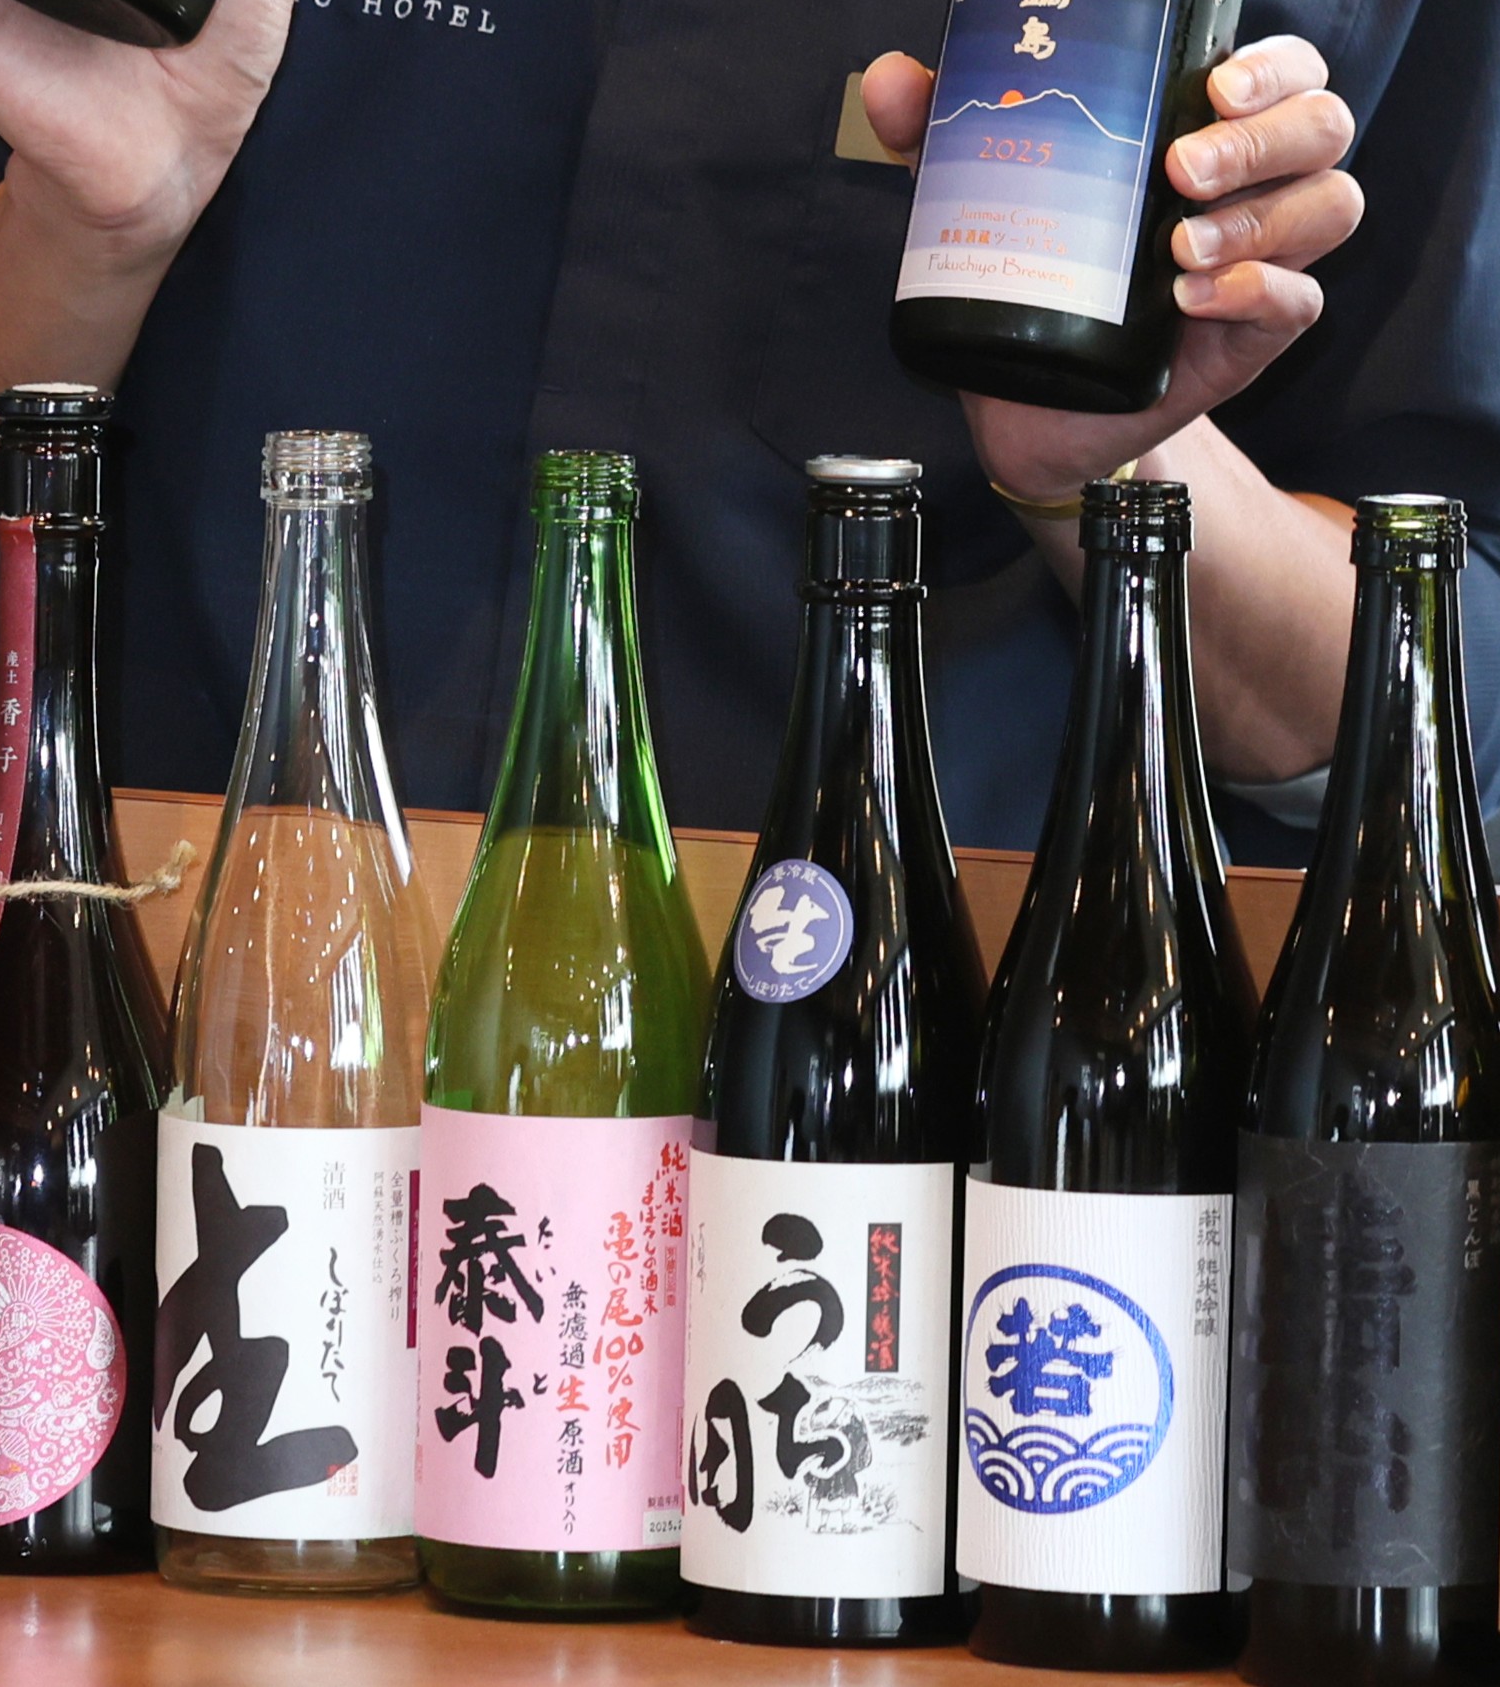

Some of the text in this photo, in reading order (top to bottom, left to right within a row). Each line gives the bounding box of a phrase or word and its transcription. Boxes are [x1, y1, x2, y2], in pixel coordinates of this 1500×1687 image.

[978, 135, 1055, 168] 2025
[927, 252, 1075, 291] Fukuchiyo Brewery
[4, 650, 20, 686] 産土
[772, 864, 820, 886] 要冷蔵
[749, 885, 830, 975] 生
[747, 974, 810, 998] しぼりたて
[323, 1160, 346, 1211] 清酒
[656, 1141, 688, 1240] 純米酒
[1463, 1179, 1484, 1270] 黒とんぼ
[637, 1181, 660, 1317] まぼろしの酒米
[1193, 1208, 1221, 1337] 若波 純米吟醸
[320, 1246, 349, 1404] しぼりたて
[433, 1183, 546, 1479] 泰斗
[985, 1296, 1113, 1419] 若
[557, 1280, 593, 1477] 無濾過生原酒
